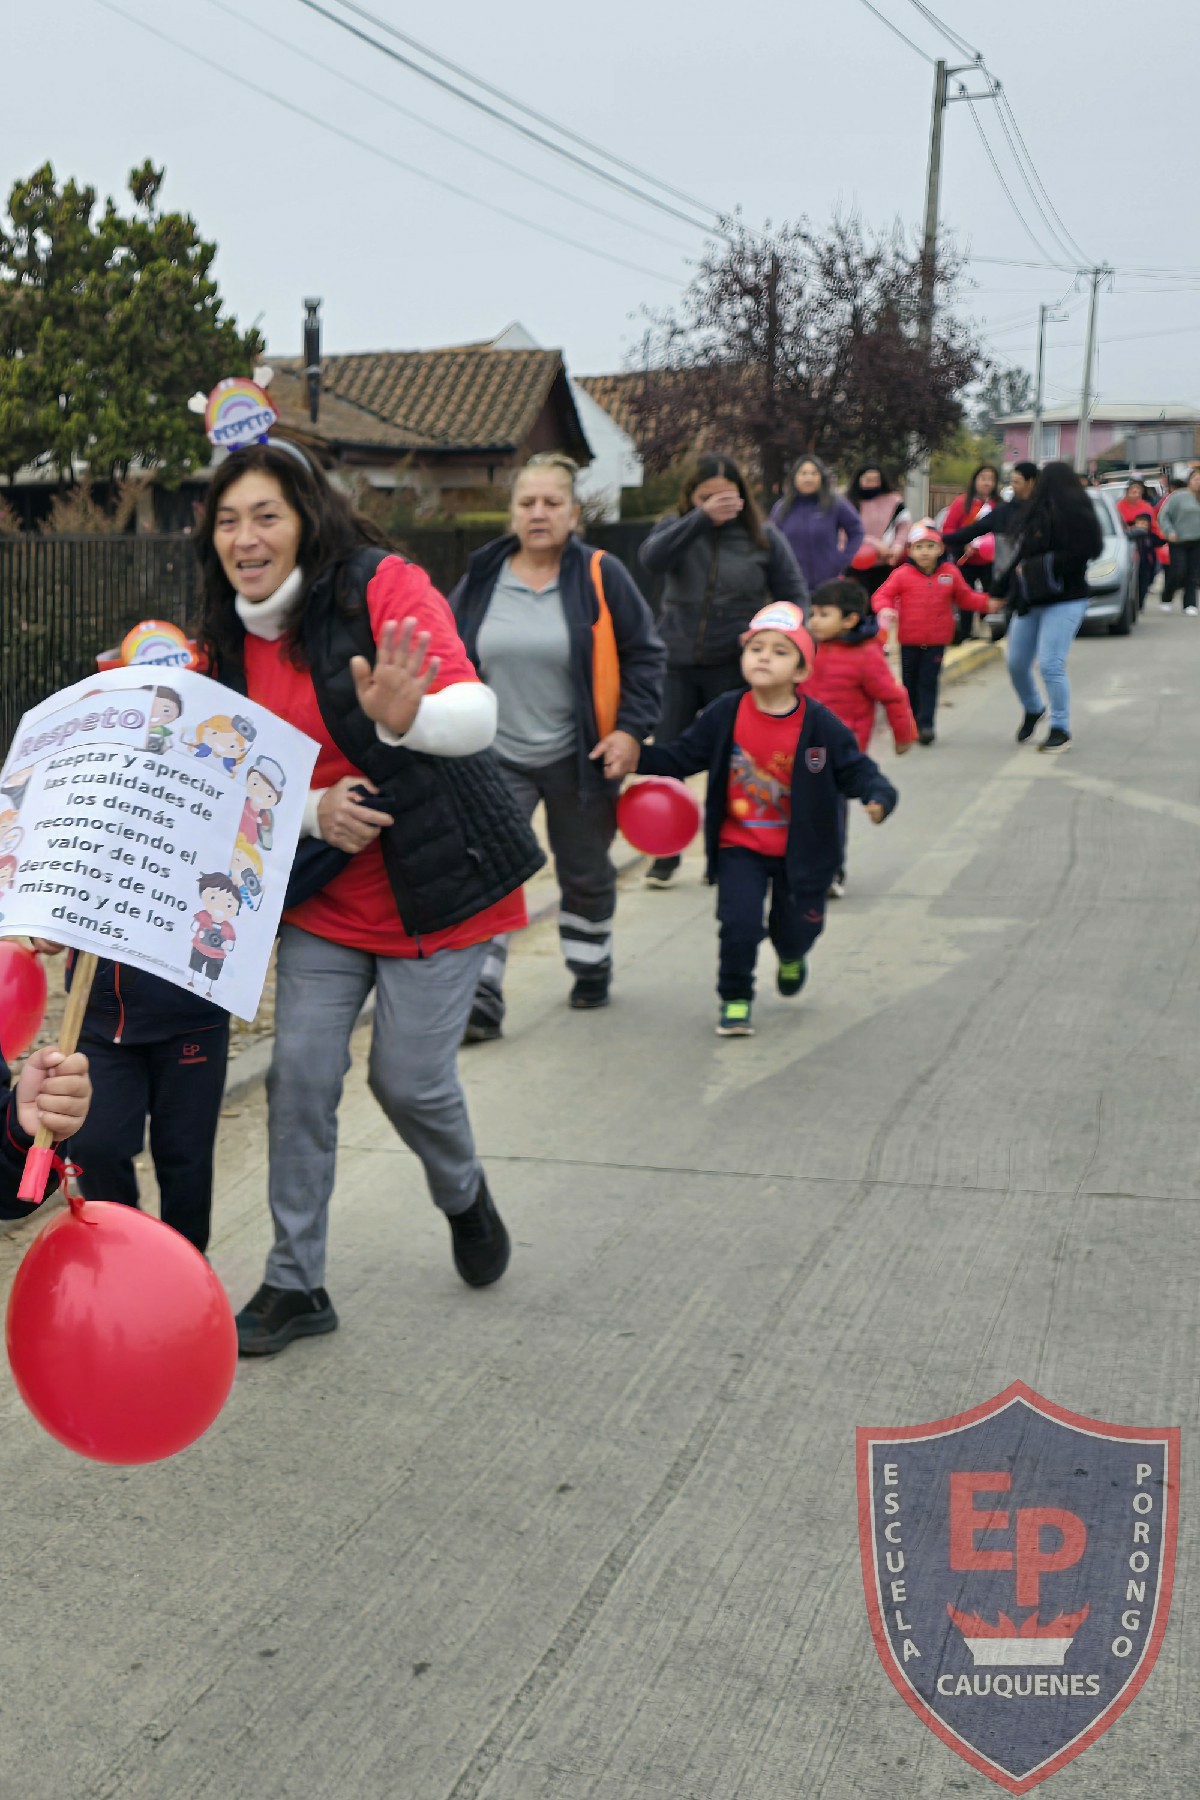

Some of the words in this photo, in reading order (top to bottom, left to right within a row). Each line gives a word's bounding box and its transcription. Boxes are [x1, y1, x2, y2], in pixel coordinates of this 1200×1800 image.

[213, 410, 273, 440] RESPETO
[19, 706, 146, 757] Respeto
[43, 776, 68, 791] las
[71, 771, 186, 808] cualidades
[190, 802, 213, 821] de
[45, 752, 119, 773] Aceptar
[121, 754, 139, 769] y
[143, 758, 225, 800] apreciar
[66, 792, 97, 806] los
[103, 795, 176, 830] demás
[33, 817, 176, 855] reconociendo
[179, 849, 198, 866] el
[47, 835, 105, 854] valor
[109, 847, 136, 866] de
[140, 855, 172, 879] los
[17, 879, 91, 902] mismo
[93, 895, 110, 910] y
[114, 900, 142, 919] de
[145, 909, 176, 932] los
[18, 859, 114, 884] derechos
[118, 876, 146, 894] de
[150, 888, 188, 912] uno
[51, 905, 130, 941] demás.
